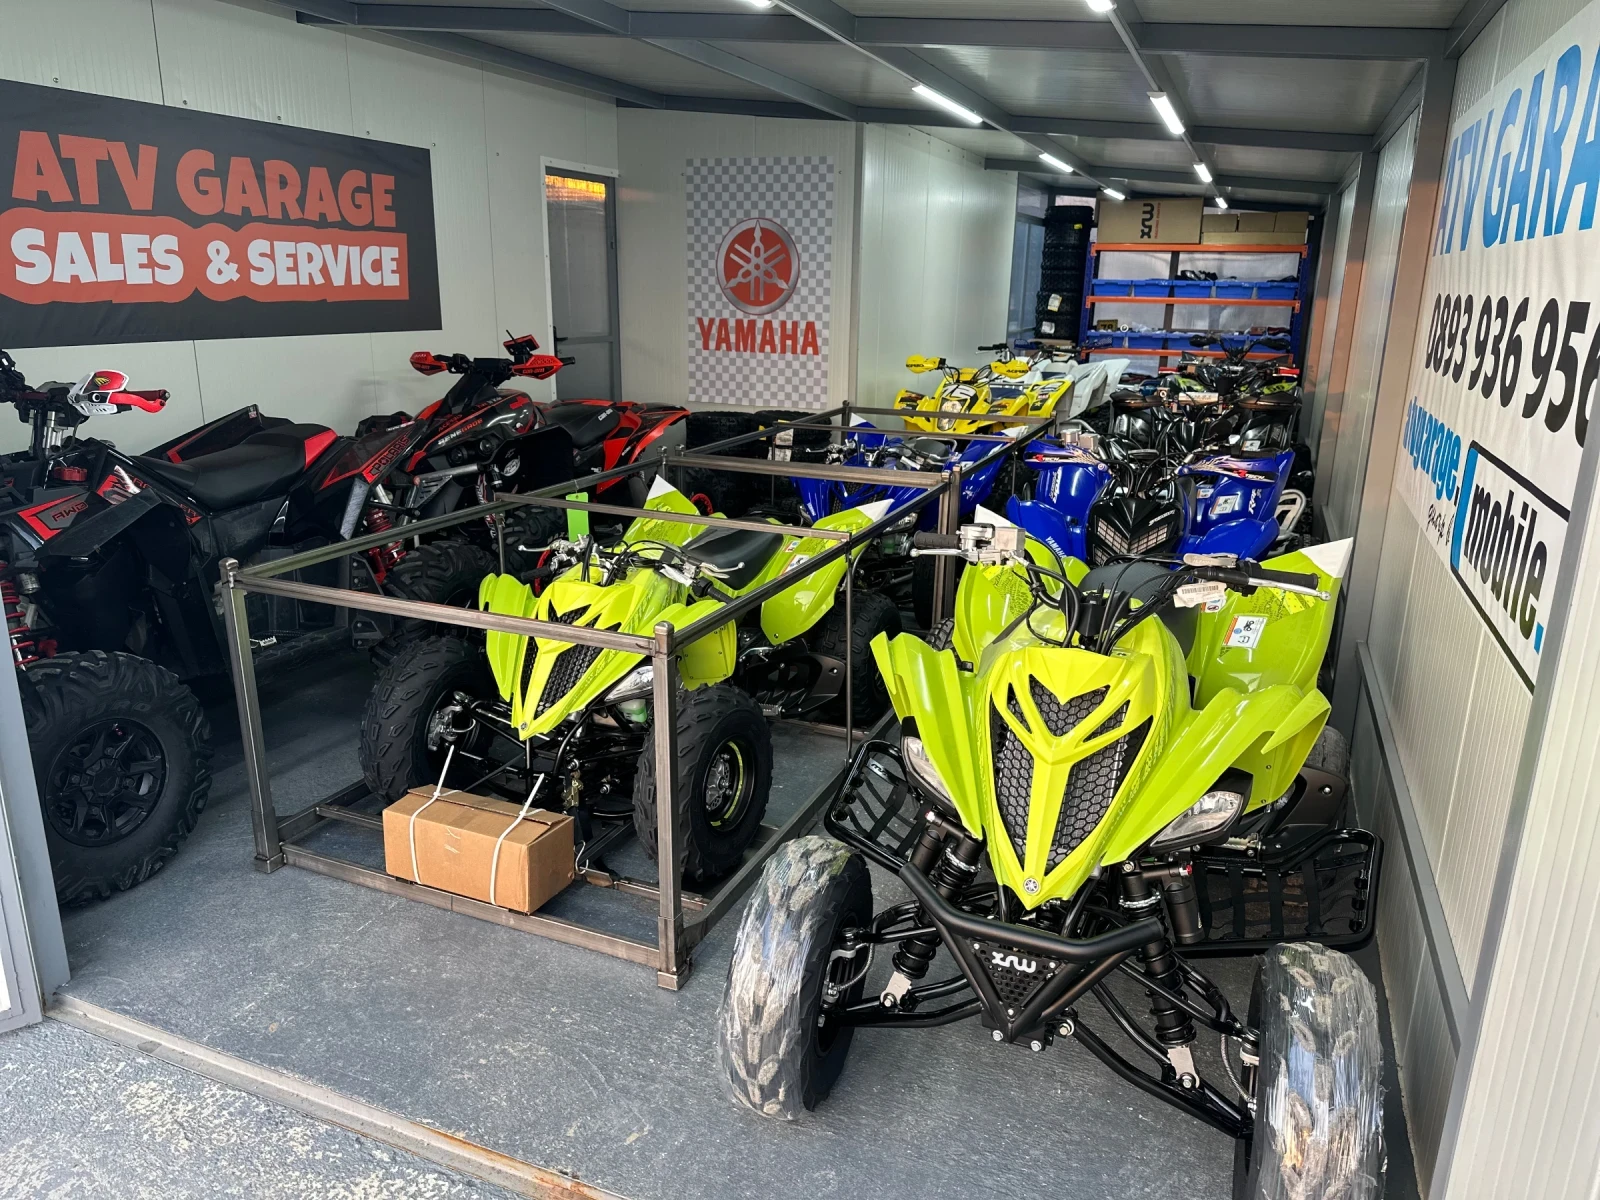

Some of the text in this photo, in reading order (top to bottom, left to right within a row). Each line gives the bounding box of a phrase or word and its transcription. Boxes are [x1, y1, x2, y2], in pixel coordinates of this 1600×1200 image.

[11, 131, 396, 228] ATV GARAGE
[1433, 108, 1494, 257] ATV
[10, 228, 400, 287] SALES & SERVICE
[697, 317, 820, 356] YAMAHA
[1425, 293, 1474, 383] 0893
[1468, 294, 1530, 408] 936
[373, 436, 411, 472] POLARIS
[52, 501, 88, 523] AWD
[1403, 396, 1460, 507] atvgarage.
[1463, 484, 1548, 655] mobile.
